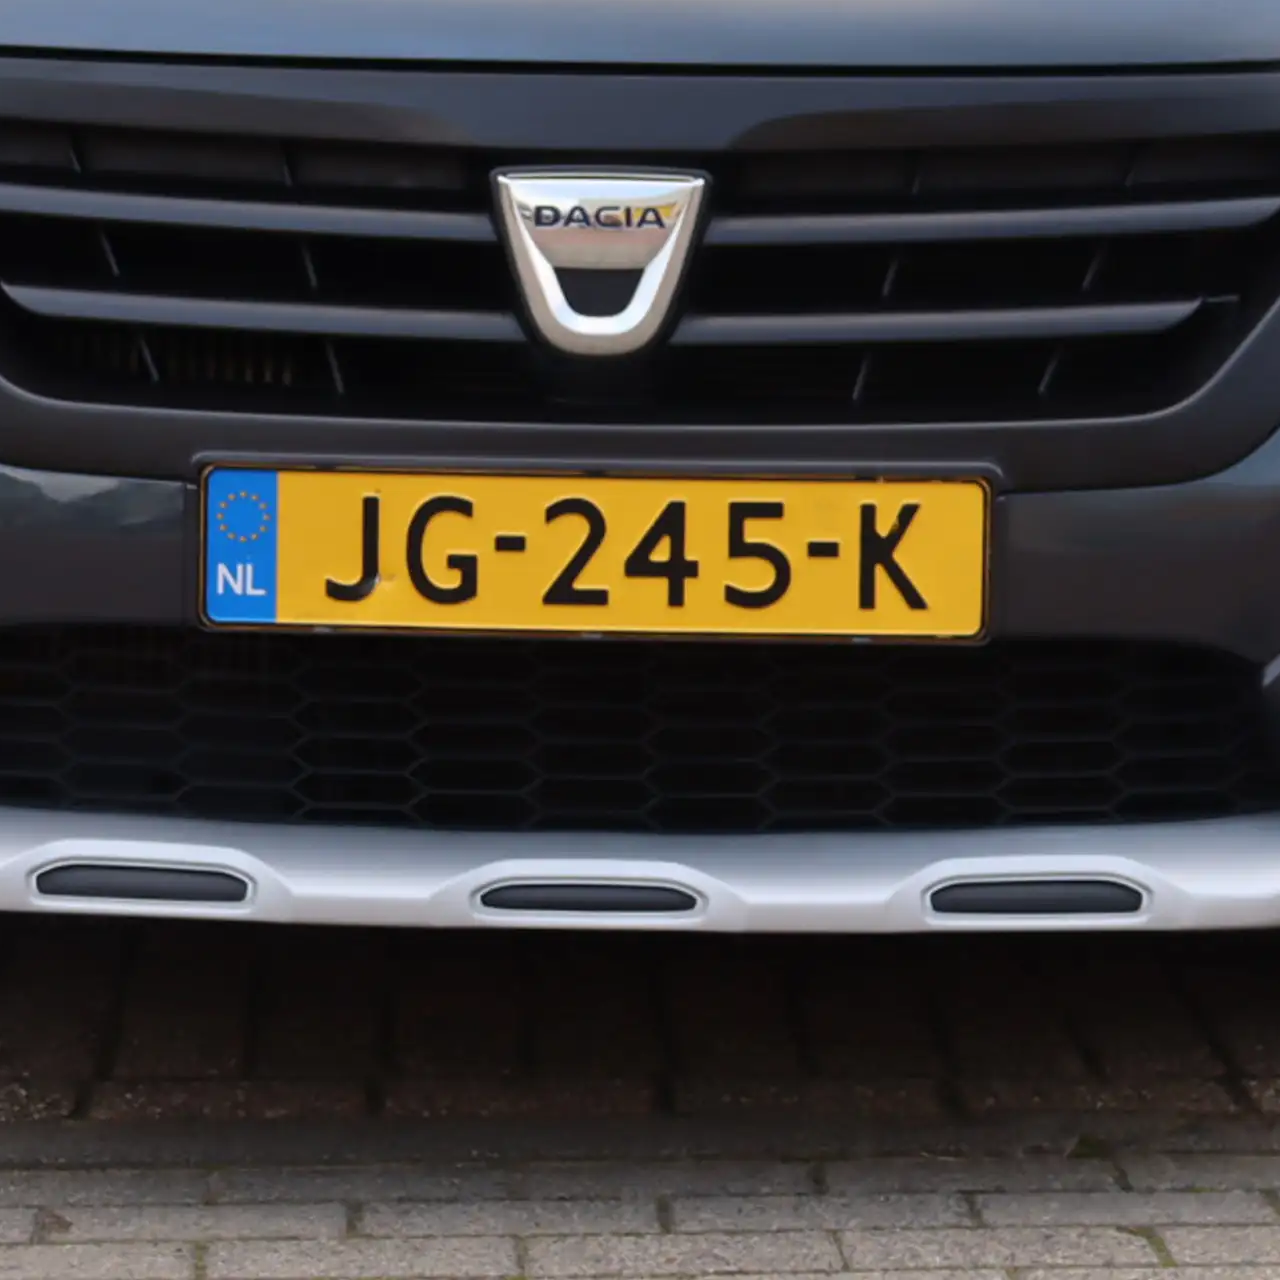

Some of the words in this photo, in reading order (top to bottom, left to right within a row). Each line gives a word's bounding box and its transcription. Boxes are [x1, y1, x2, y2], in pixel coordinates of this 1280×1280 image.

[533, 205, 666, 229] DACIA
[324, 495, 928, 610] JG-245-K
[217, 563, 267, 596] NL
